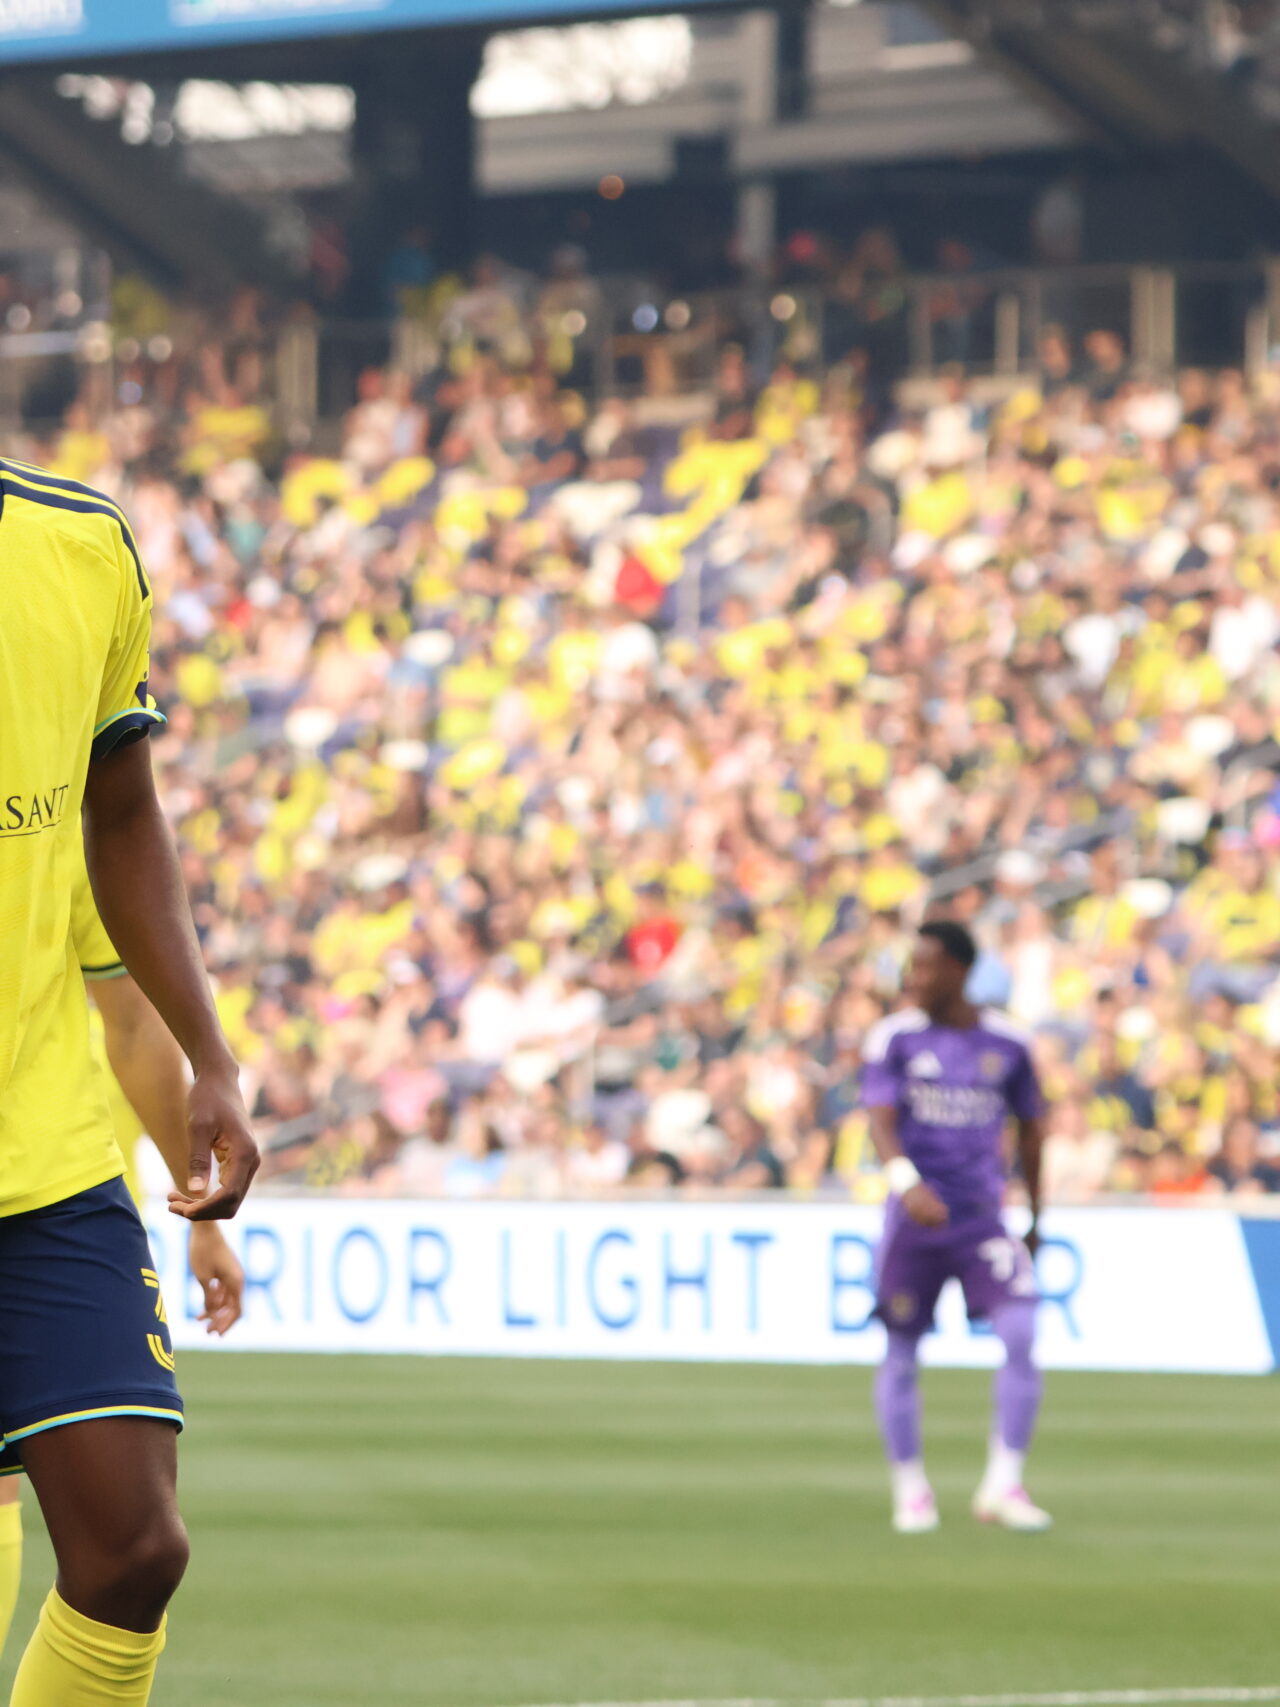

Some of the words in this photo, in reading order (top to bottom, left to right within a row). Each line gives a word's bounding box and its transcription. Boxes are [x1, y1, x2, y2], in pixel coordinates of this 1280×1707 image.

[146, 1224, 453, 1327] RIOR
[500, 1227, 775, 1333] LIGHT
[830, 1232, 1085, 1340] BR
